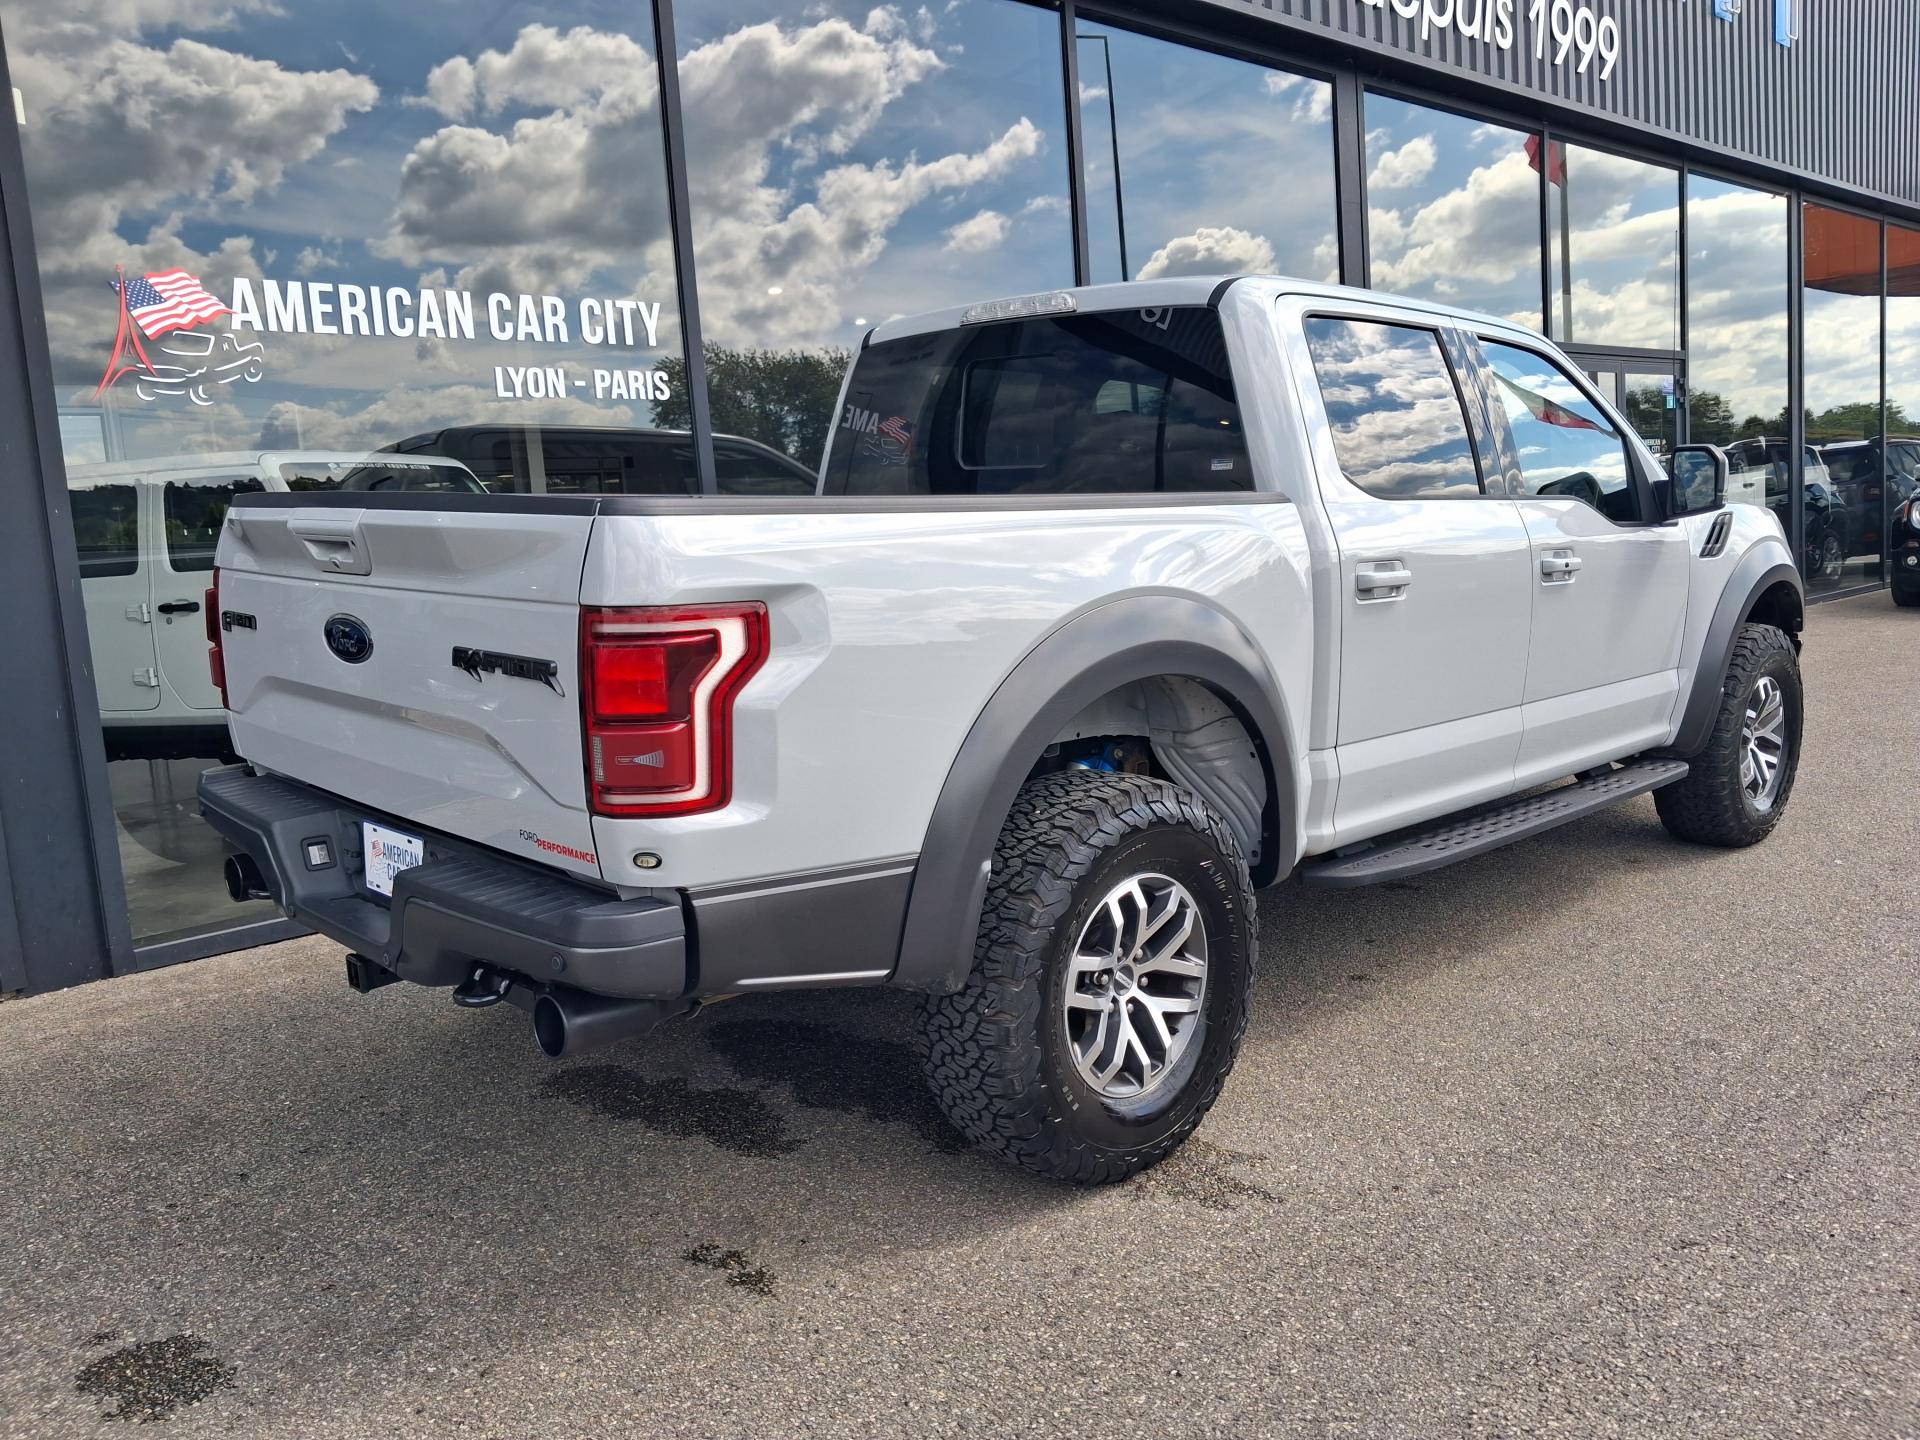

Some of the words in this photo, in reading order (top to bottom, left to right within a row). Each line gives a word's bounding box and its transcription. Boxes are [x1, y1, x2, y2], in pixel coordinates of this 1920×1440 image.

[1528, 0, 1619, 81] 1999
[231, 277, 475, 340] AMERICAN
[487, 292, 569, 343] CAR
[579, 297, 661, 347] CITY
[494, 366, 567, 399] LYON
[593, 369, 671, 401] PARIS
[330, 624, 358, 653] Ford
[382, 842, 420, 868] AMERICAN
[519, 829, 539, 844] FORD
[537, 839, 596, 864] PERFORMANCE
